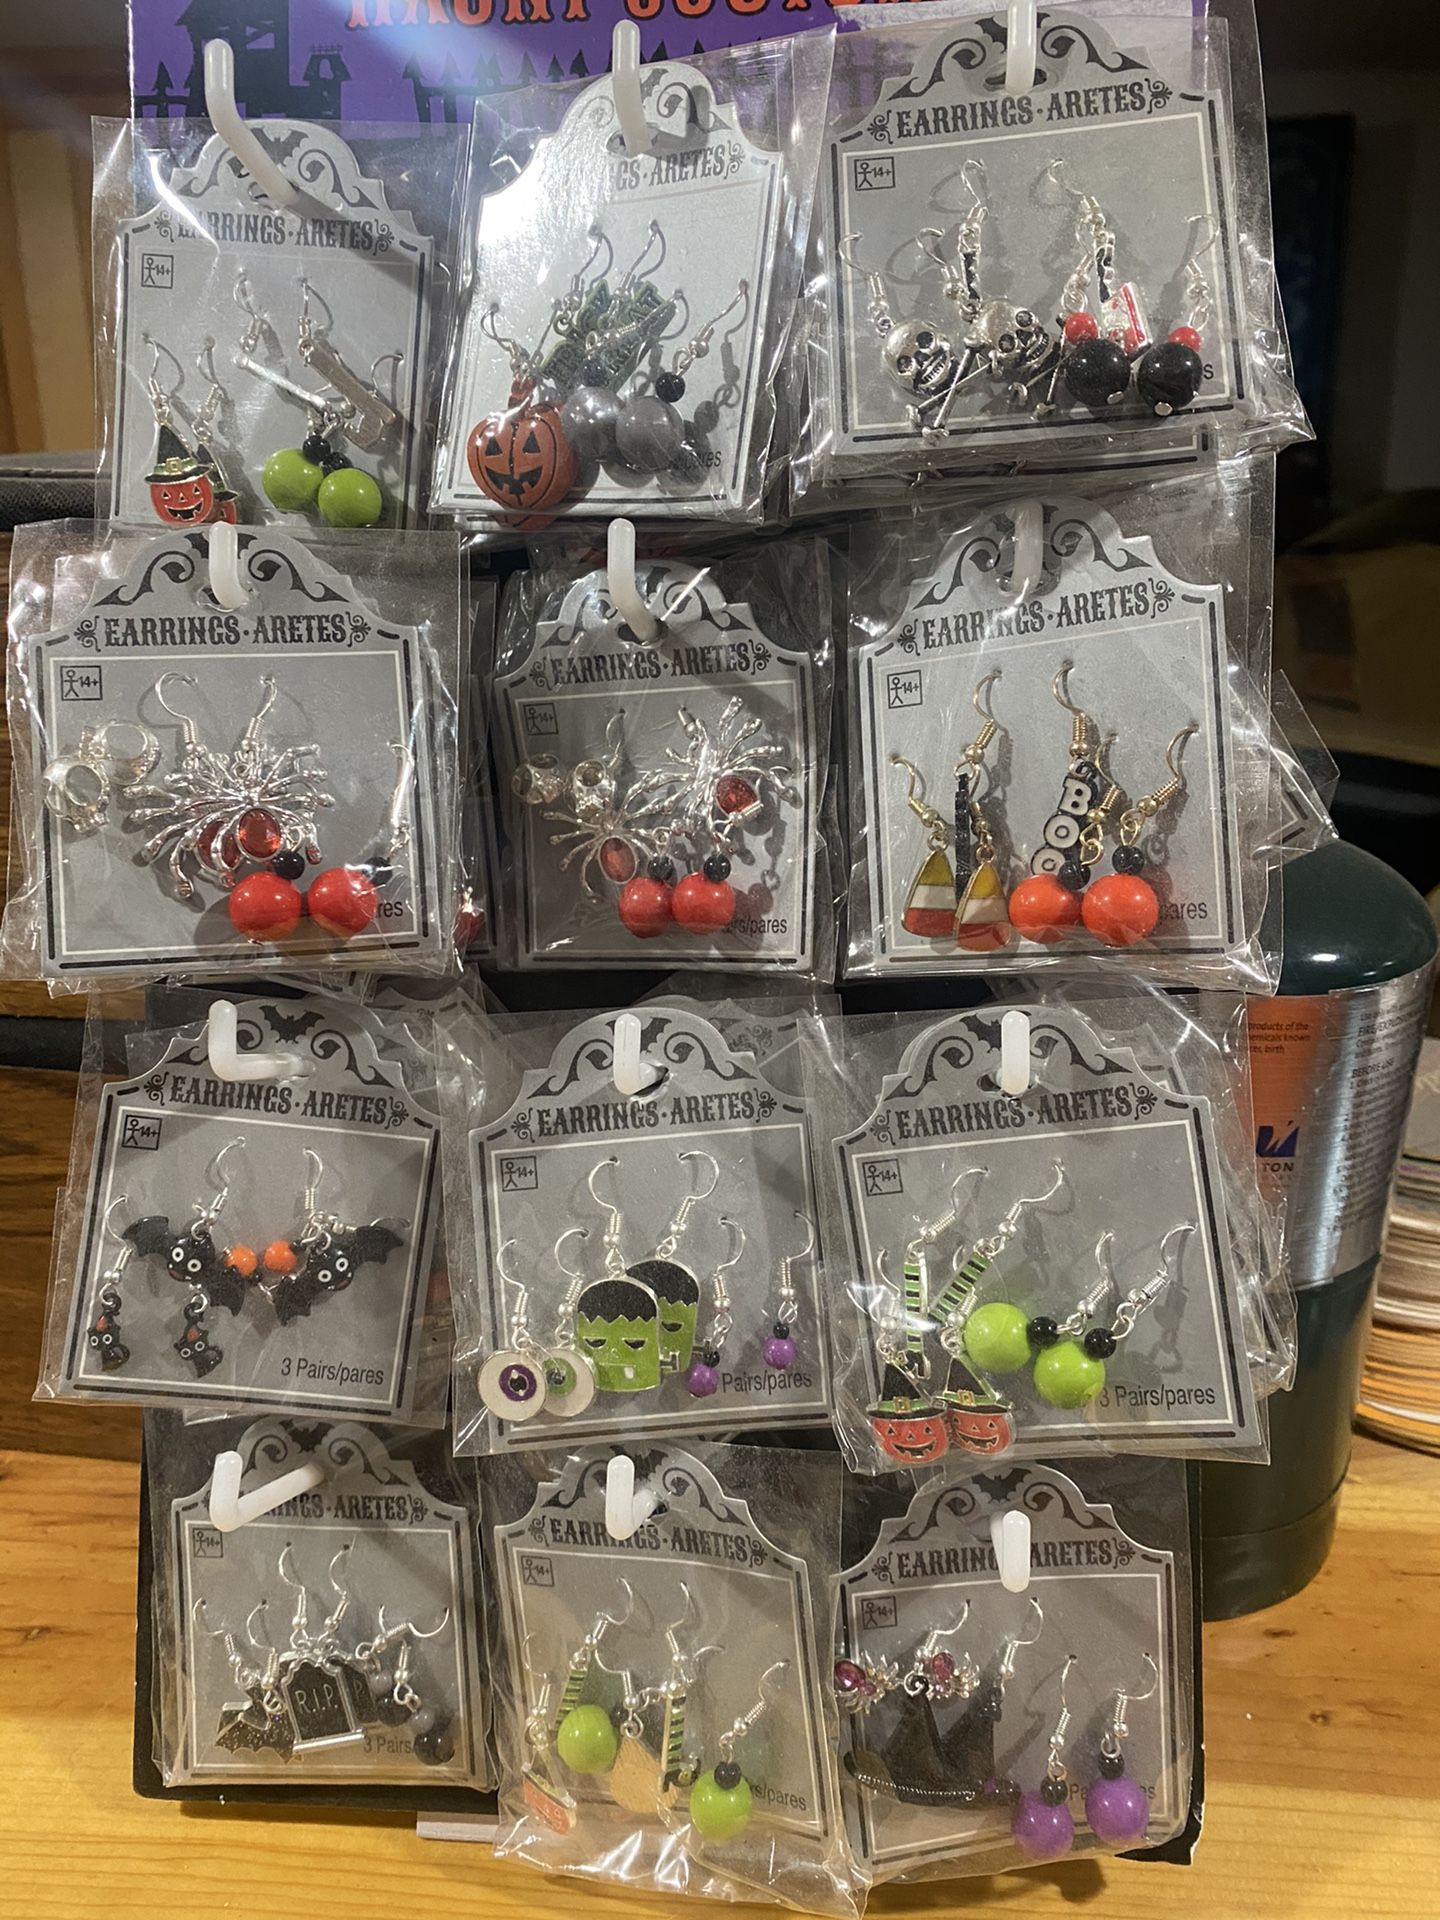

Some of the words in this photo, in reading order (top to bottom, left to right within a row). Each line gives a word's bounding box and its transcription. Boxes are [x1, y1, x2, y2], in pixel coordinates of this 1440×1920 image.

[1262, 1162, 1294, 1172] TON
[281, 1357, 291, 1376] 3
[296, 1358, 384, 1386] Pairs/pares
[722, 1370, 813, 1395] Pairs/pares
[1115, 1384, 1215, 1410] Pairs/pares
